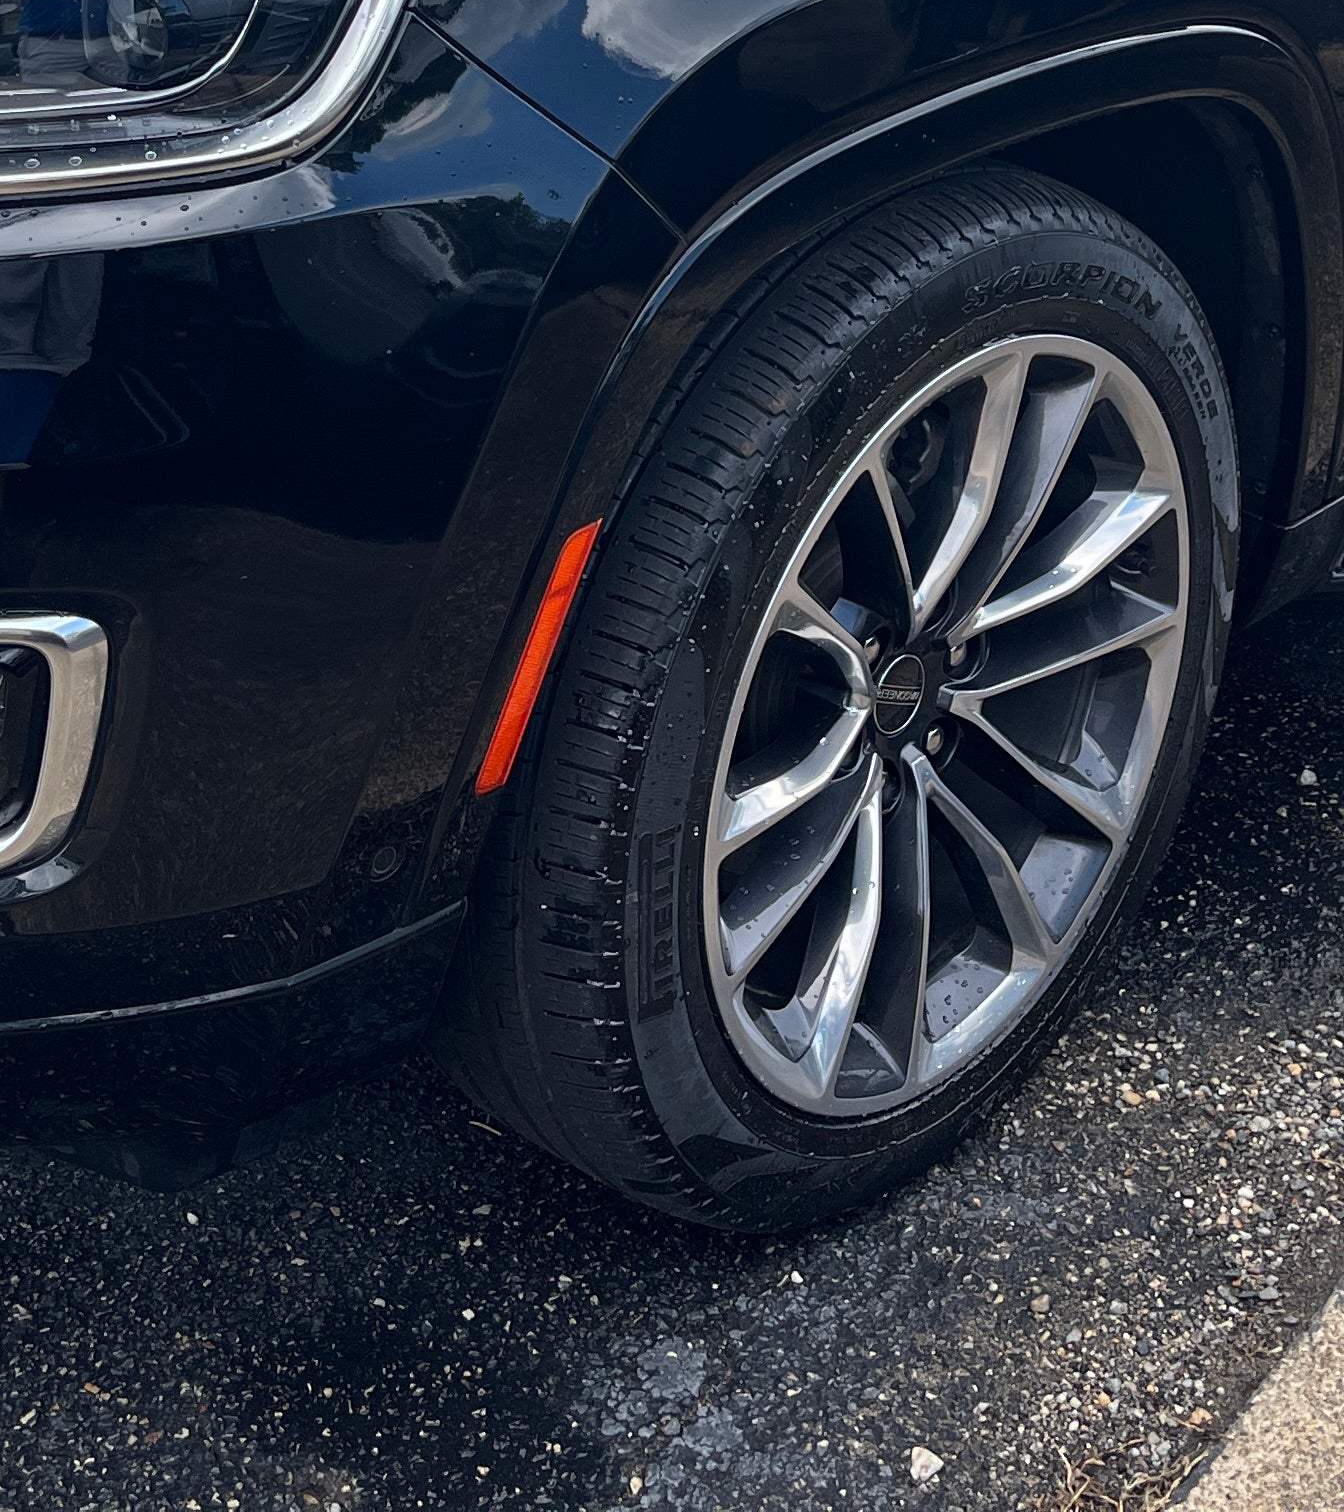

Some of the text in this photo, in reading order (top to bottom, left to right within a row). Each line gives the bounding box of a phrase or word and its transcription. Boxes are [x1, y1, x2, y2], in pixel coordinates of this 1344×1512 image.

[963, 261, 1162, 319] SCORPION
[1174, 322, 1219, 419] VERDE
[637, 824, 678, 1024] PIRELLI
